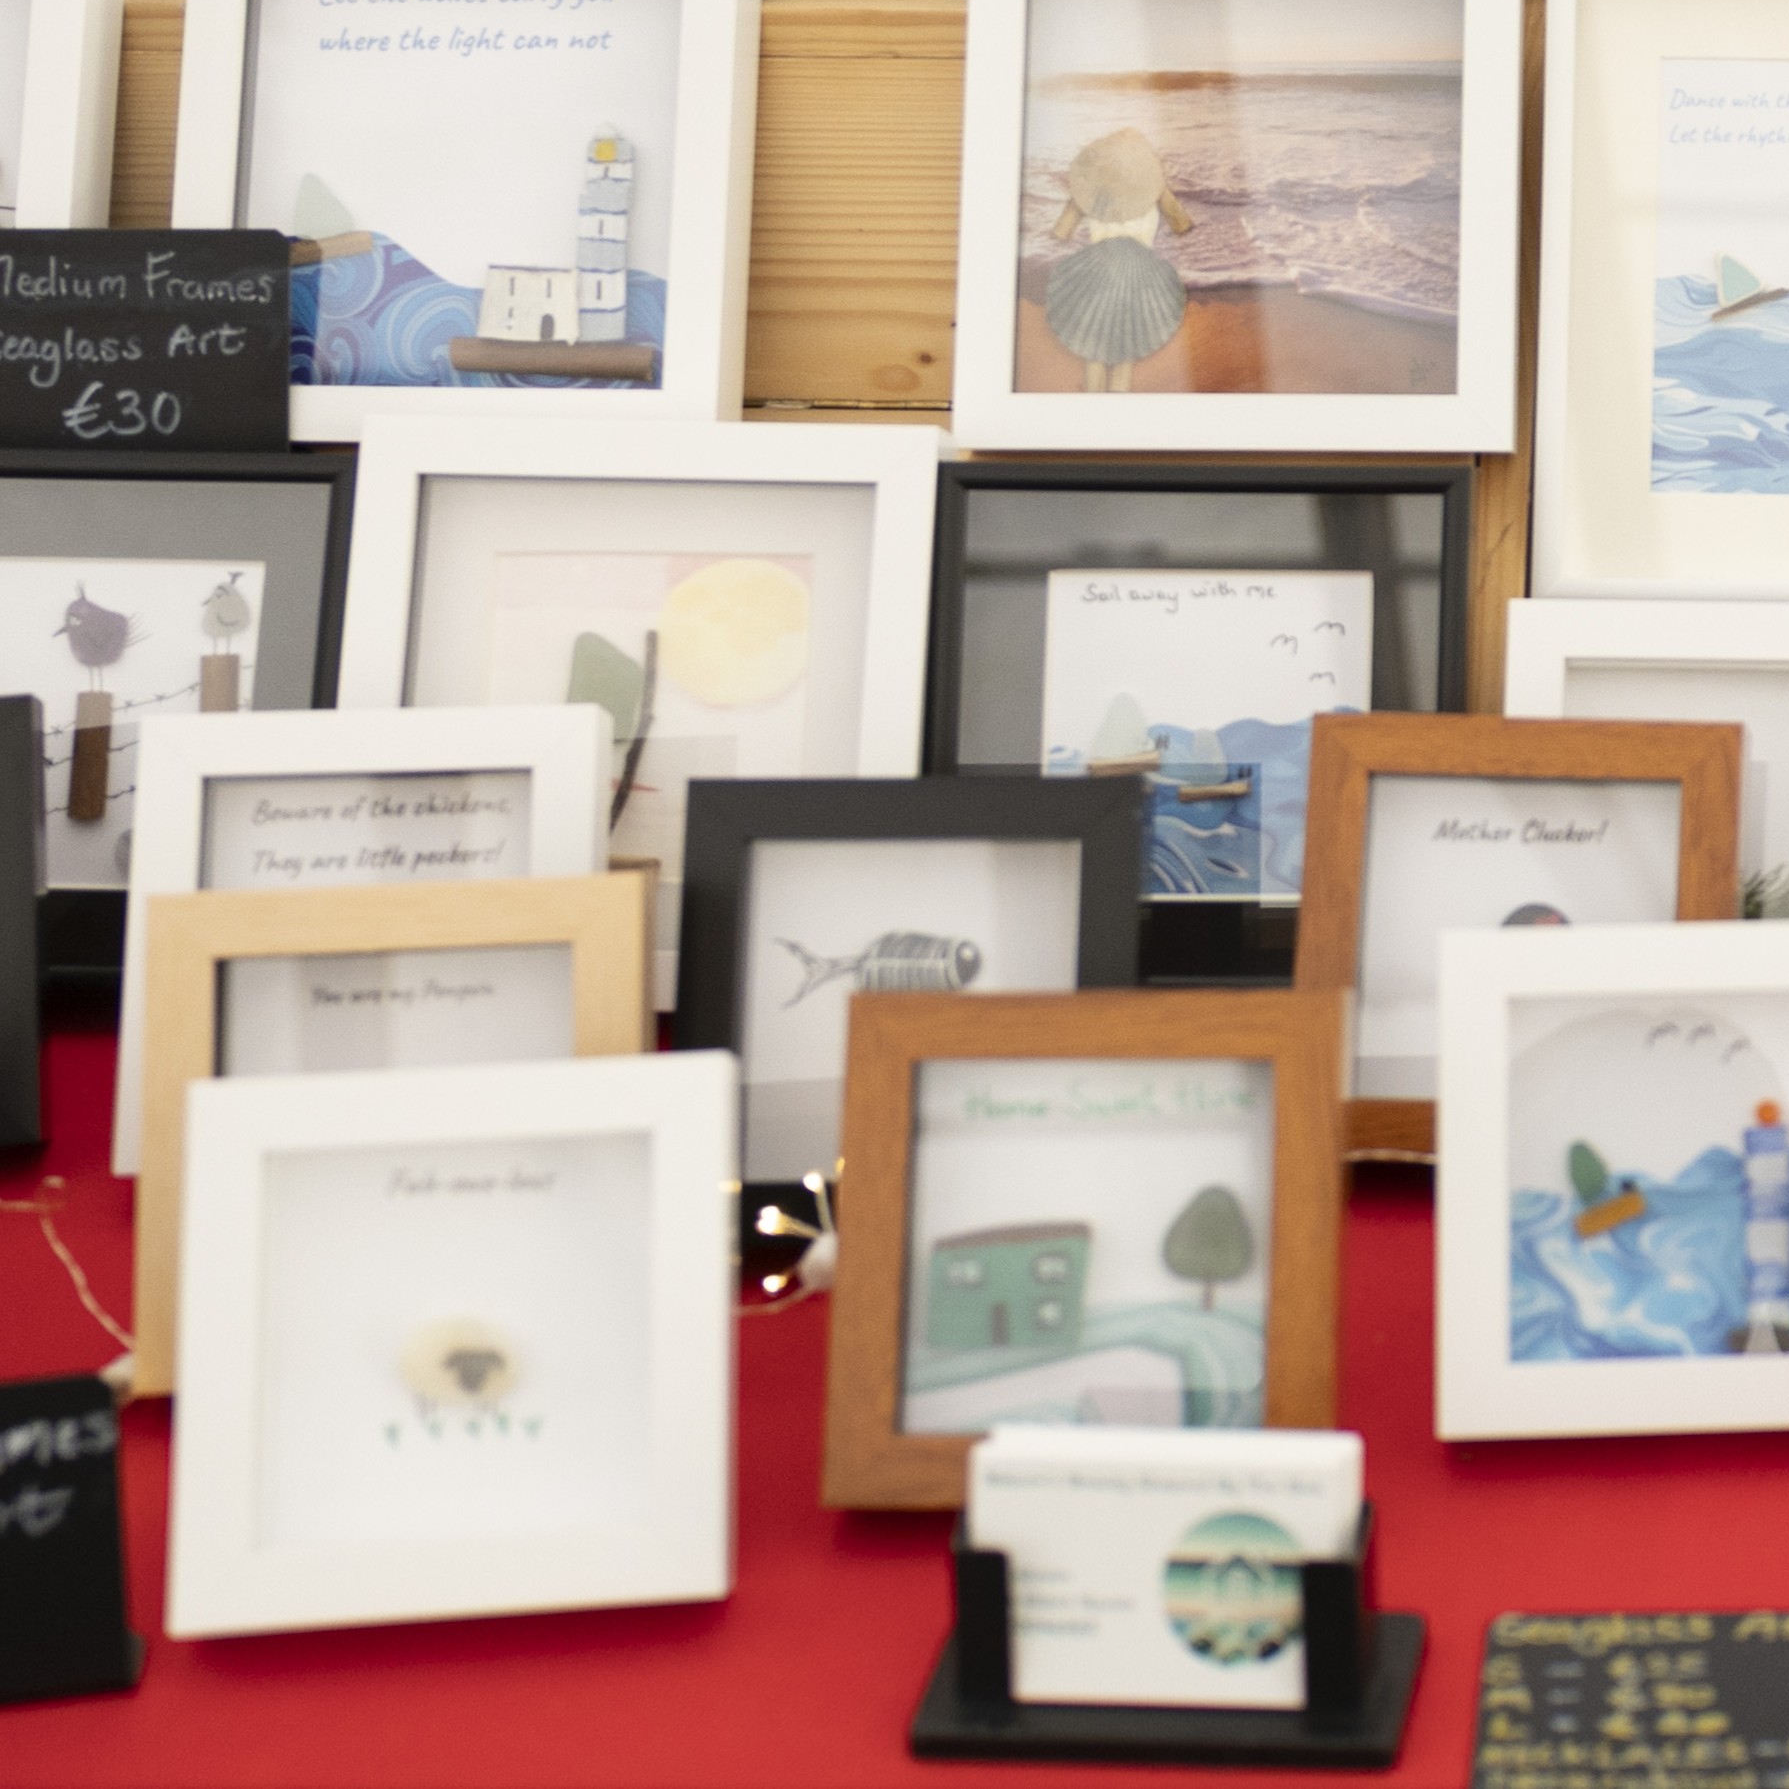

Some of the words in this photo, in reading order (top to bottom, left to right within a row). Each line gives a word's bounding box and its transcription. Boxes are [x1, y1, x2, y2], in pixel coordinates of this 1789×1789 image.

[320, 28, 391, 52] where
[400, 28, 440, 50] the
[449, 27, 504, 56] light
[514, 34, 559, 50] can
[568, 30, 612, 50] not
[1669, 88, 1726, 110] Dance
[1731, 92, 1769, 108] with
[1669, 125, 1697, 144] Let
[1703, 126, 1733, 143] the
[144, 250, 277, 304] Frames
[0, 326, 143, 388] eaglass
[166, 324, 247, 357] Art
[61, 381, 182, 440] €30
[1130, 589, 1179, 614] away
[1191, 580, 1238, 598] with
[1247, 585, 1276, 598] me
